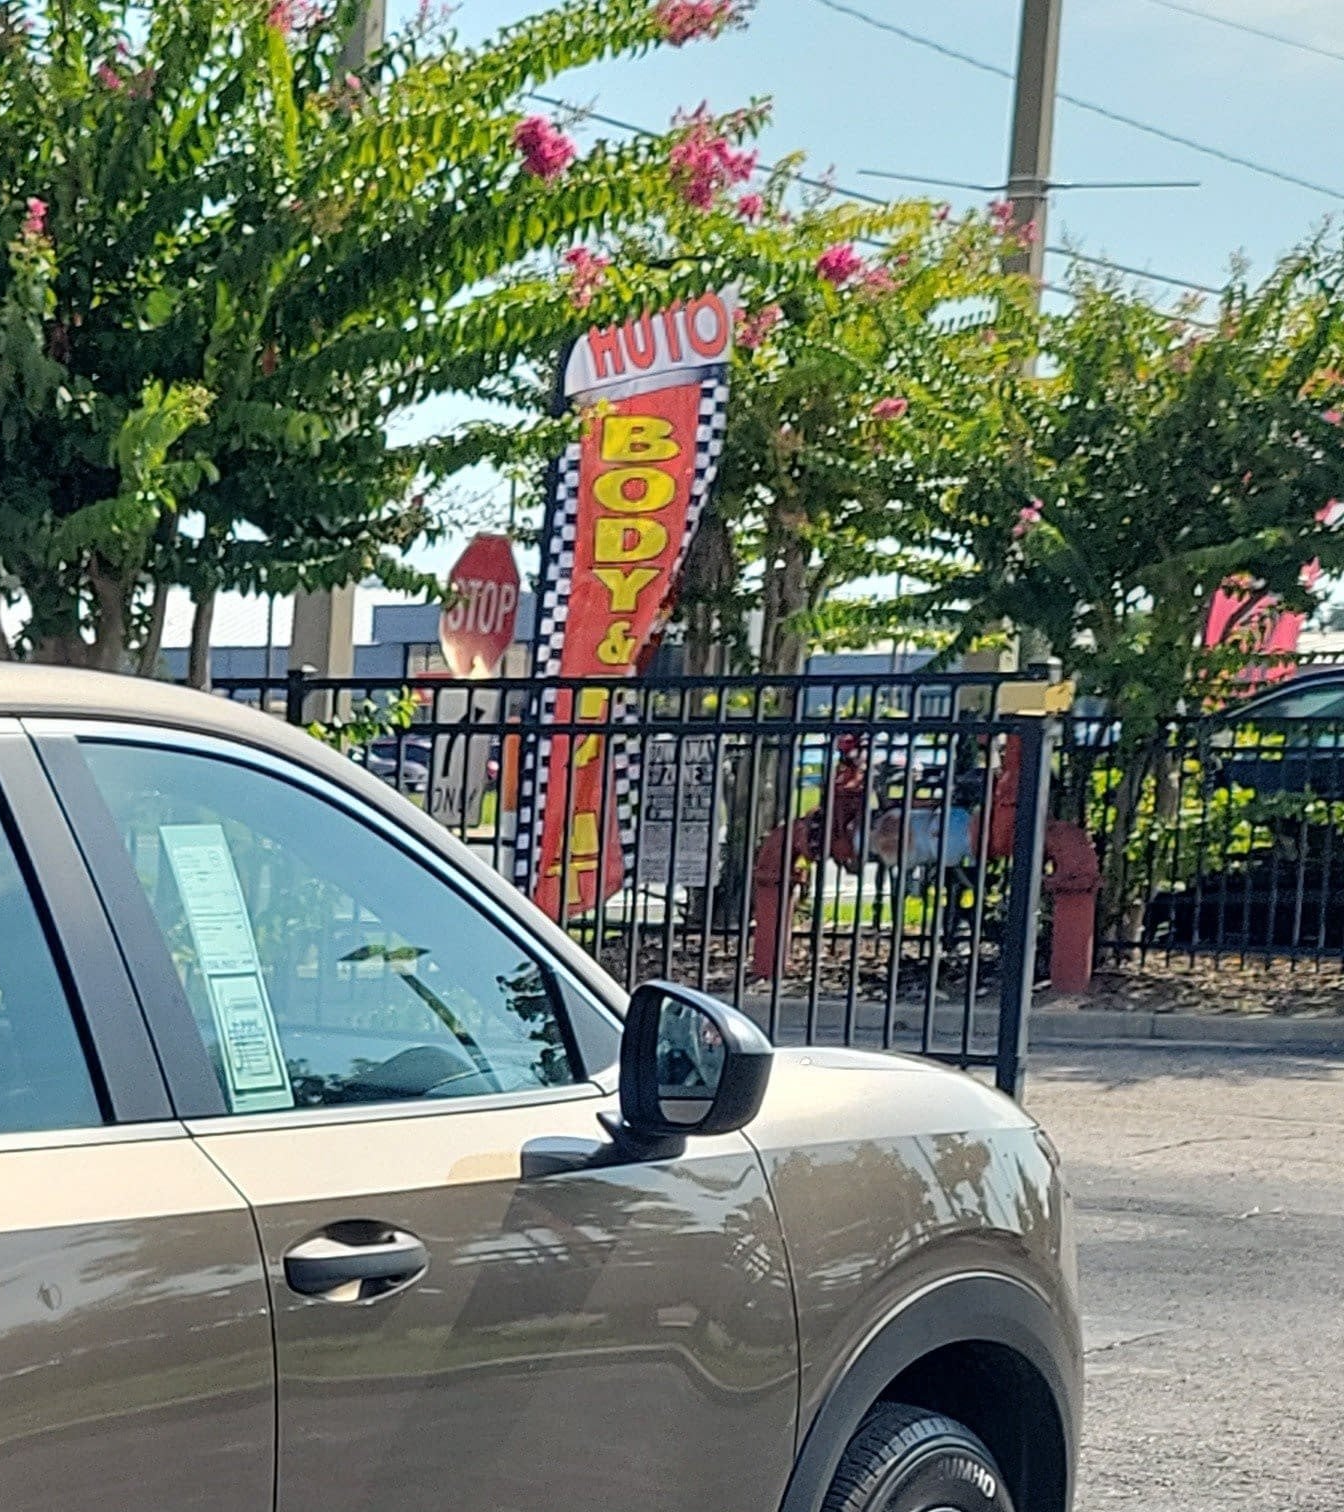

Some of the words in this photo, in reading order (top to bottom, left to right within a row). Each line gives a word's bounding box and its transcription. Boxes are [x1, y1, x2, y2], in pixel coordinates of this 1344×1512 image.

[588, 292, 729, 379] AUTO
[593, 414, 681, 613] BODY
[446, 577, 517, 634] STOP
